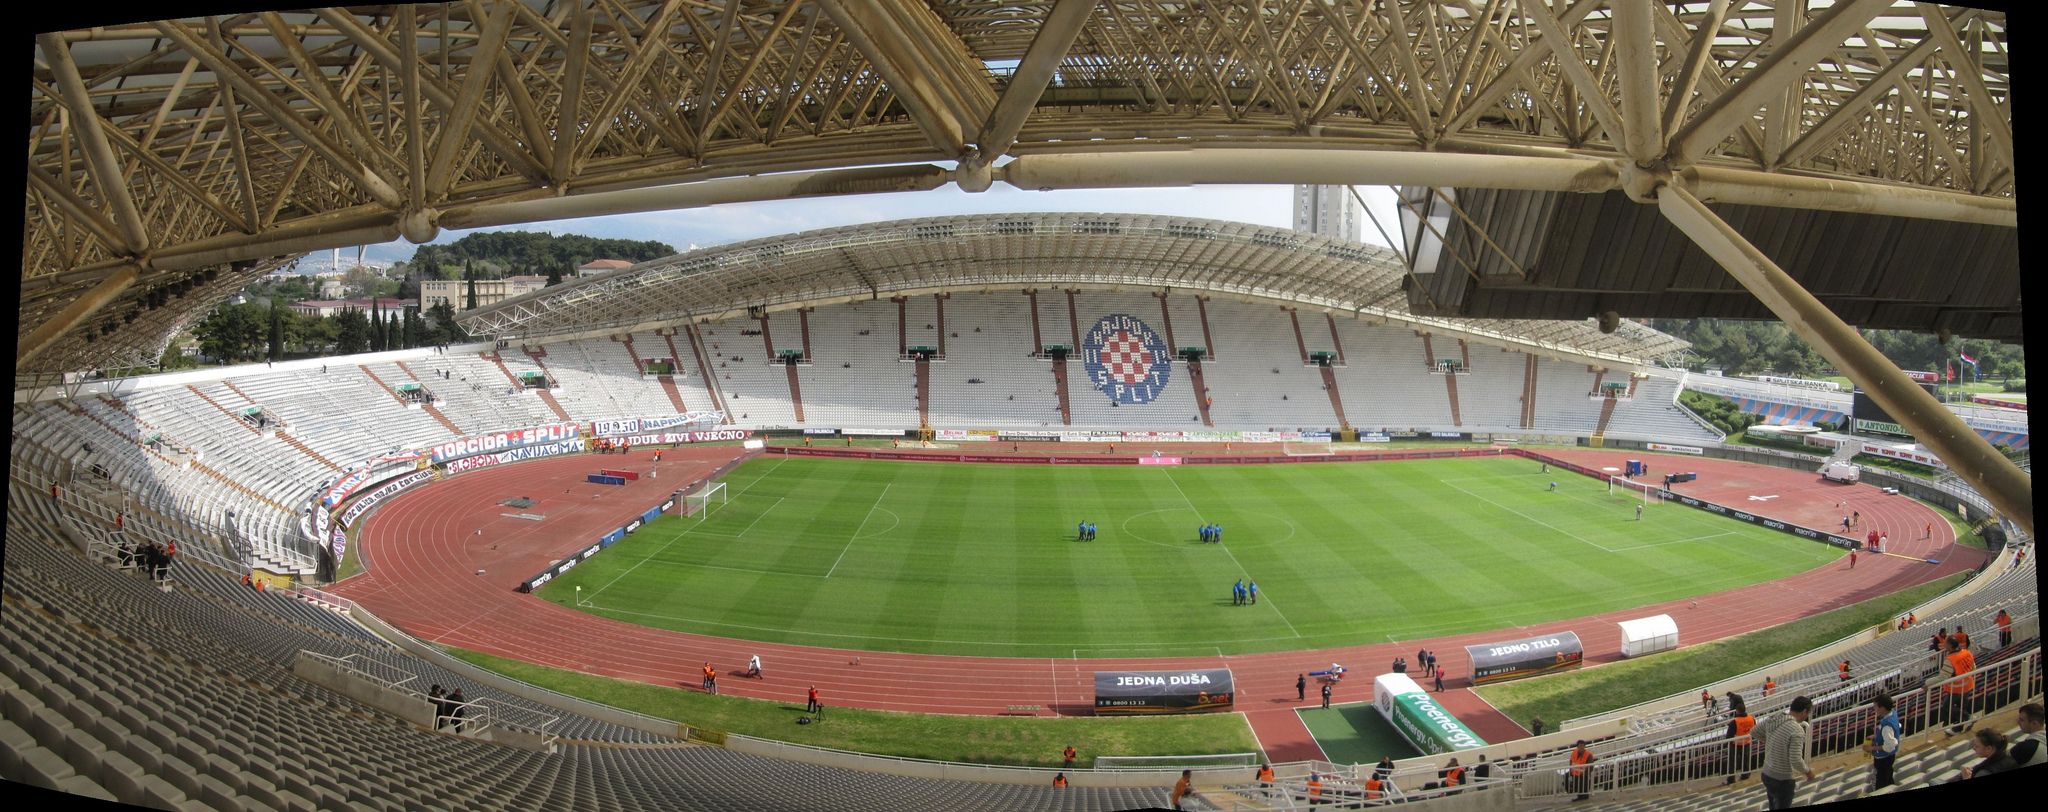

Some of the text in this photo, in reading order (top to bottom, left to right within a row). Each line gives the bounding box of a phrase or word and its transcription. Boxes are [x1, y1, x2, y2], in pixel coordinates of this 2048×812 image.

[1093, 316, 1153, 345] HAJDUK
[1098, 370, 1159, 401] SPLIT
[1772, 378, 1828, 389] SPLITSKA BANKA
[644, 415, 688, 429] NAPRID
[435, 425, 577, 460] TORCIDA SPLIT
[664, 432, 690, 444] ŽIVI
[694, 430, 745, 441] VJEČNO
[452, 456, 500, 473] SLOBODA
[1707, 503, 1726, 513] macron
[1735, 511, 1755, 522] macron
[1763, 519, 1785, 530] macron
[1795, 527, 1817, 538] macron
[1828, 535, 1851, 547] macron
[558, 558, 577, 574] macron
[531, 572, 552, 589] macron
[1489, 638, 1560, 657] JEDNO TILO
[1117, 673, 1211, 686] JEDNA DUŠA
[1407, 694, 1483, 748] Proenergy
